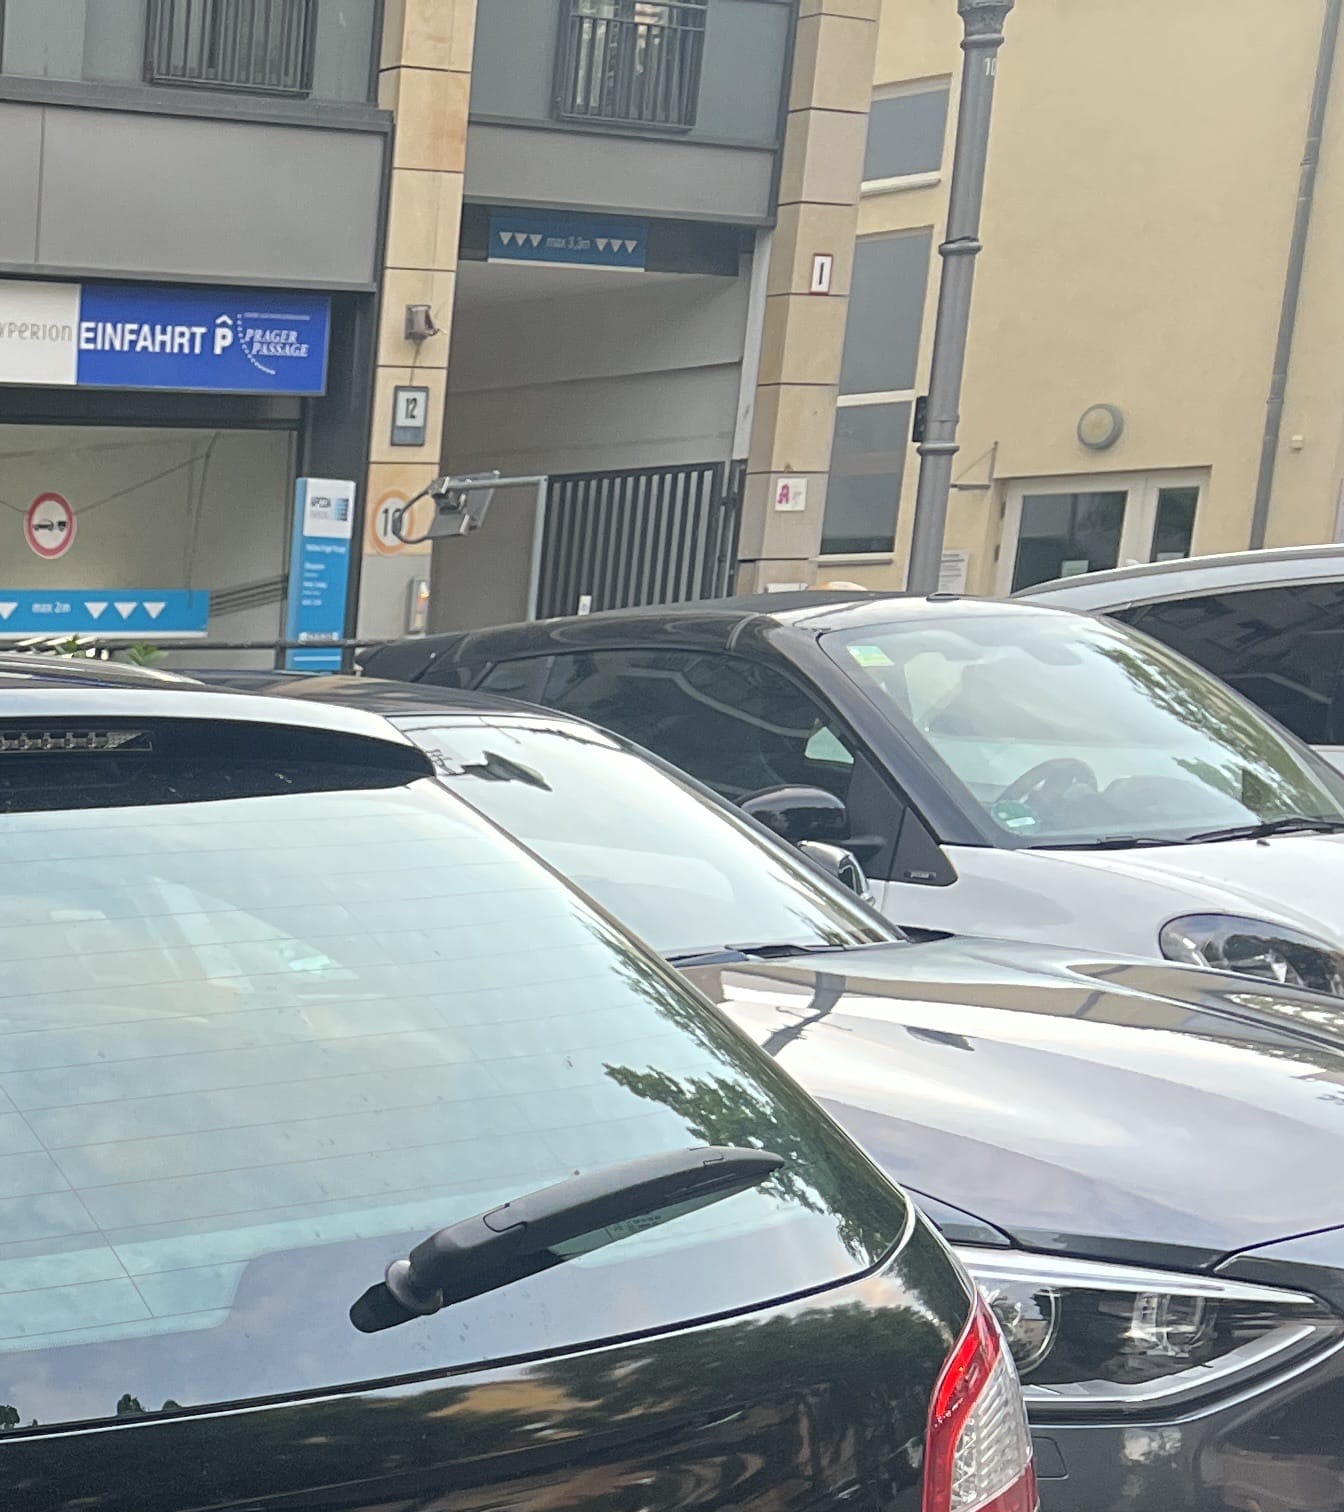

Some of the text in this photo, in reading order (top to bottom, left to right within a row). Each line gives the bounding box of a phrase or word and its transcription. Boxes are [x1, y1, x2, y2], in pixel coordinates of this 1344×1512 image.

[80, 321, 207, 355] EINFAHRT
[244, 329, 297, 343] PRAGER
[251, 342, 309, 357] PASSAGE
[405, 397, 417, 419] 12
